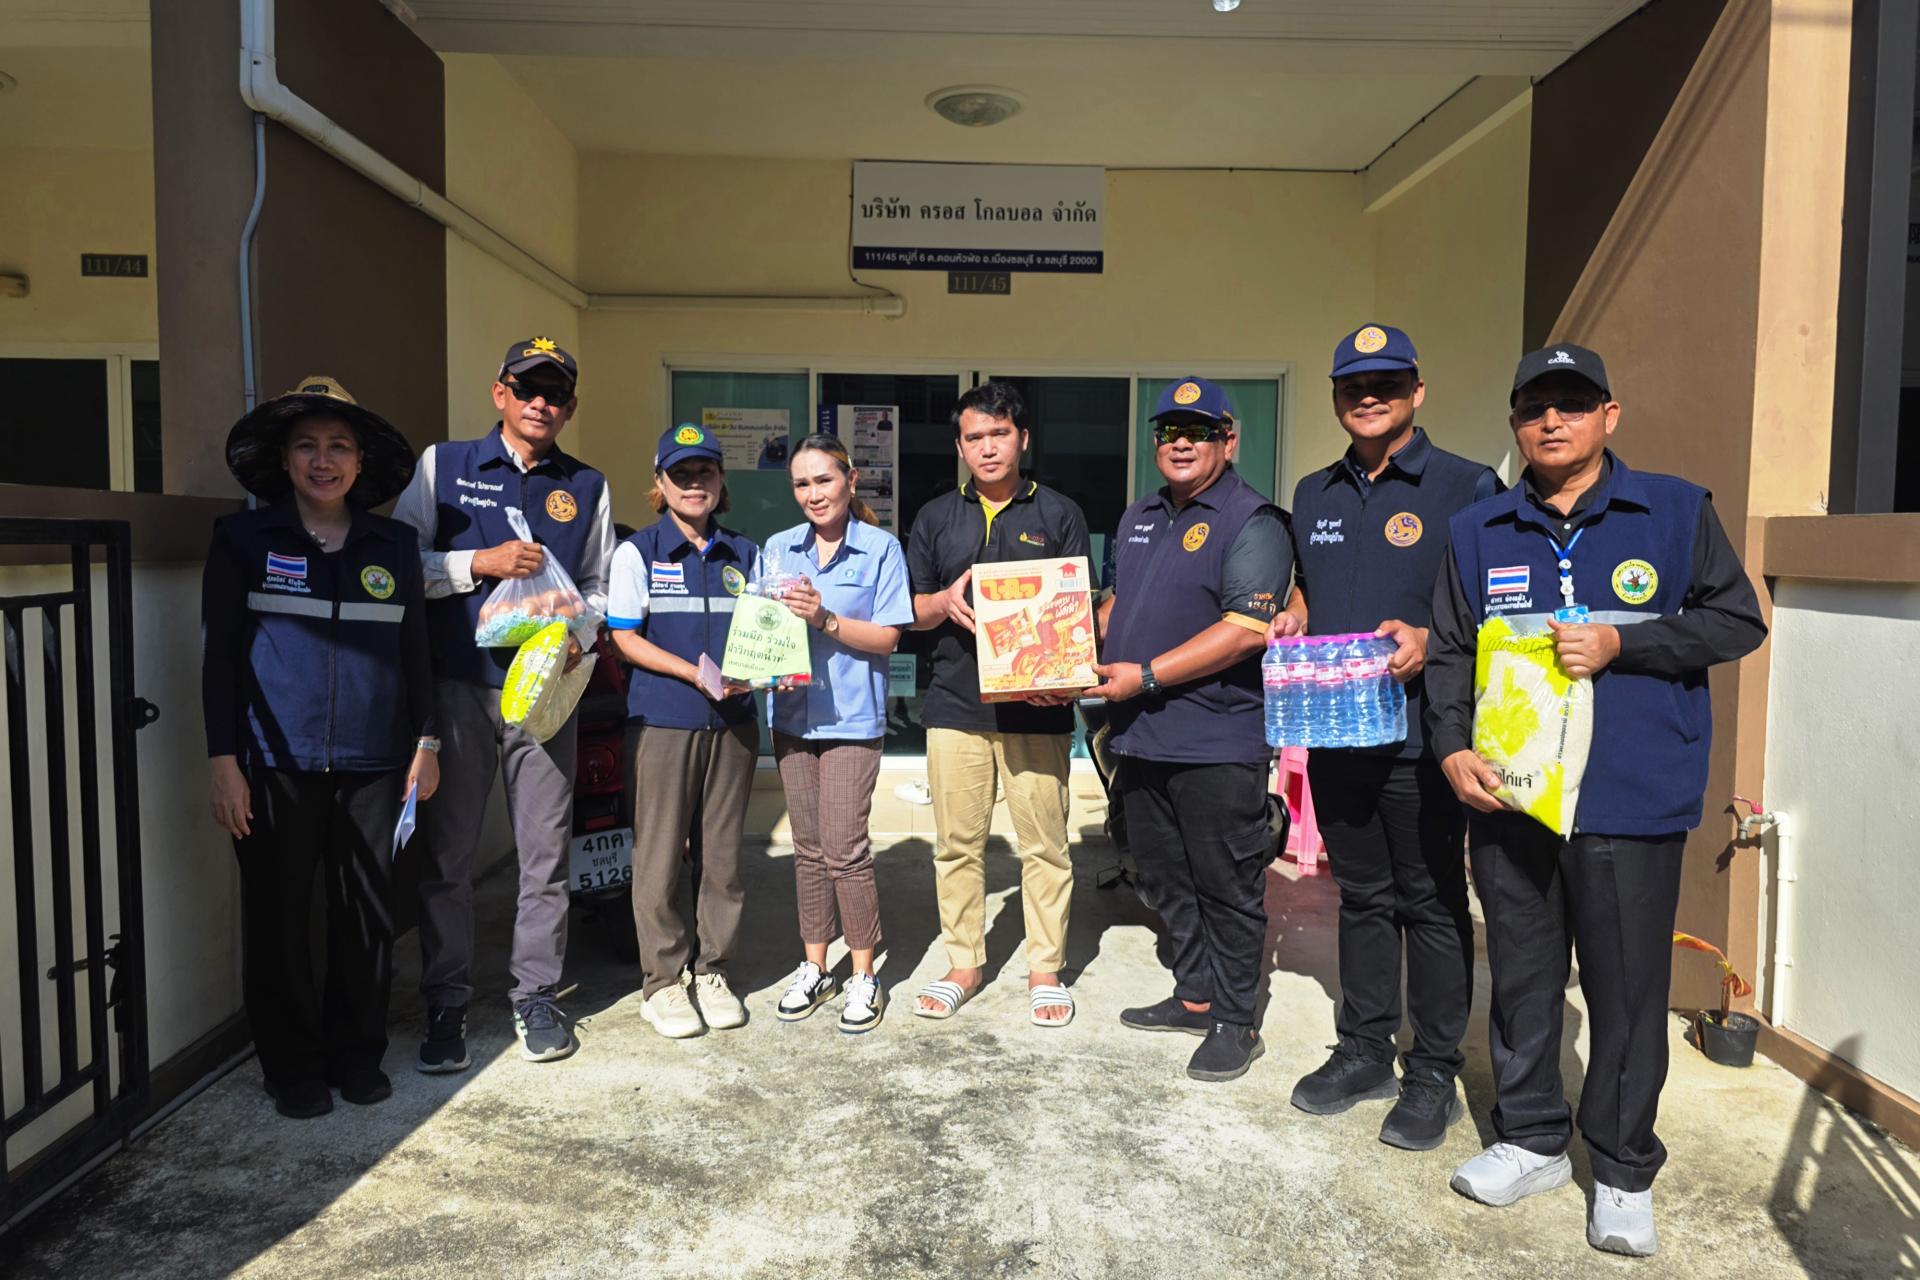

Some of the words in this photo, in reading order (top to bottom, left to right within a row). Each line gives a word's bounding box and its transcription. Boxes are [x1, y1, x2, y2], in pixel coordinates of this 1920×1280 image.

[861, 196, 910, 219] บริษัท
[920, 204, 965, 220] ครอส
[974, 197, 1042, 222] โกลบอล
[1052, 200, 1096, 222] จำกัด
[865, 252, 896, 262] 111/45
[919, 252, 927, 262] 6
[952, 275, 1007, 291] 111/45
[579, 865, 632, 889] 5126
